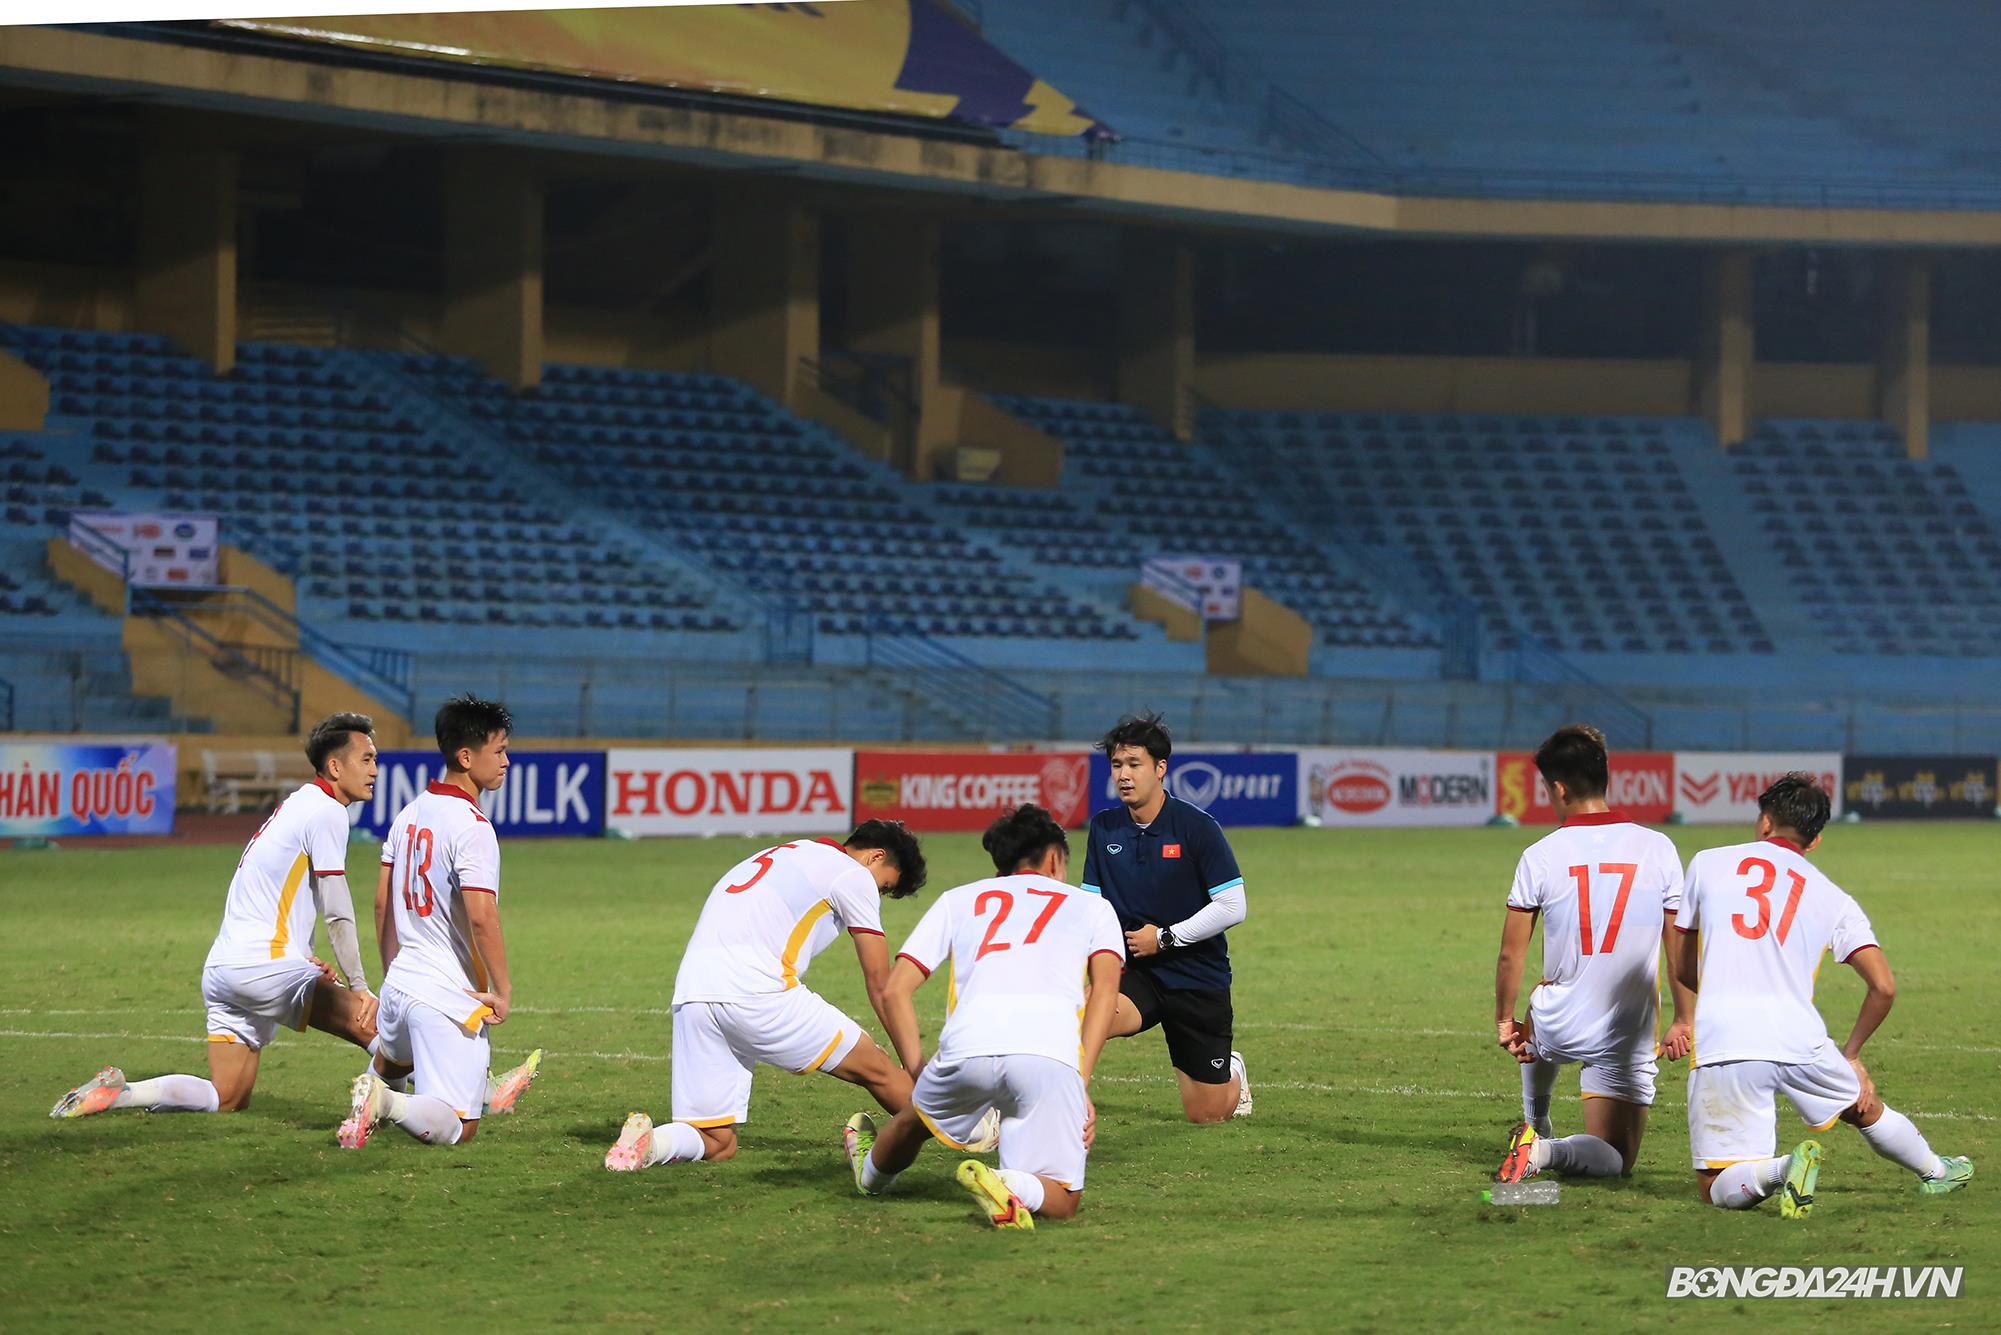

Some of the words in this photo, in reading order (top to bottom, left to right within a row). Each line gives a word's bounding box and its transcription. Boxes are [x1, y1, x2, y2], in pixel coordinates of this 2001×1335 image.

[71, 752, 155, 825] QUỐC
[348, 763, 591, 826] INMILK
[612, 770, 846, 817] HONDA
[901, 774, 957, 809] KING
[958, 773, 1041, 807] COFFEE
[1221, 774, 1282, 799] SPORT
[1399, 773, 1488, 806] MODERN
[403, 824, 434, 917] 13
[725, 844, 799, 894] 5
[974, 887, 1069, 962] 27
[1568, 863, 1638, 956] 17
[1731, 856, 1807, 946] 31
